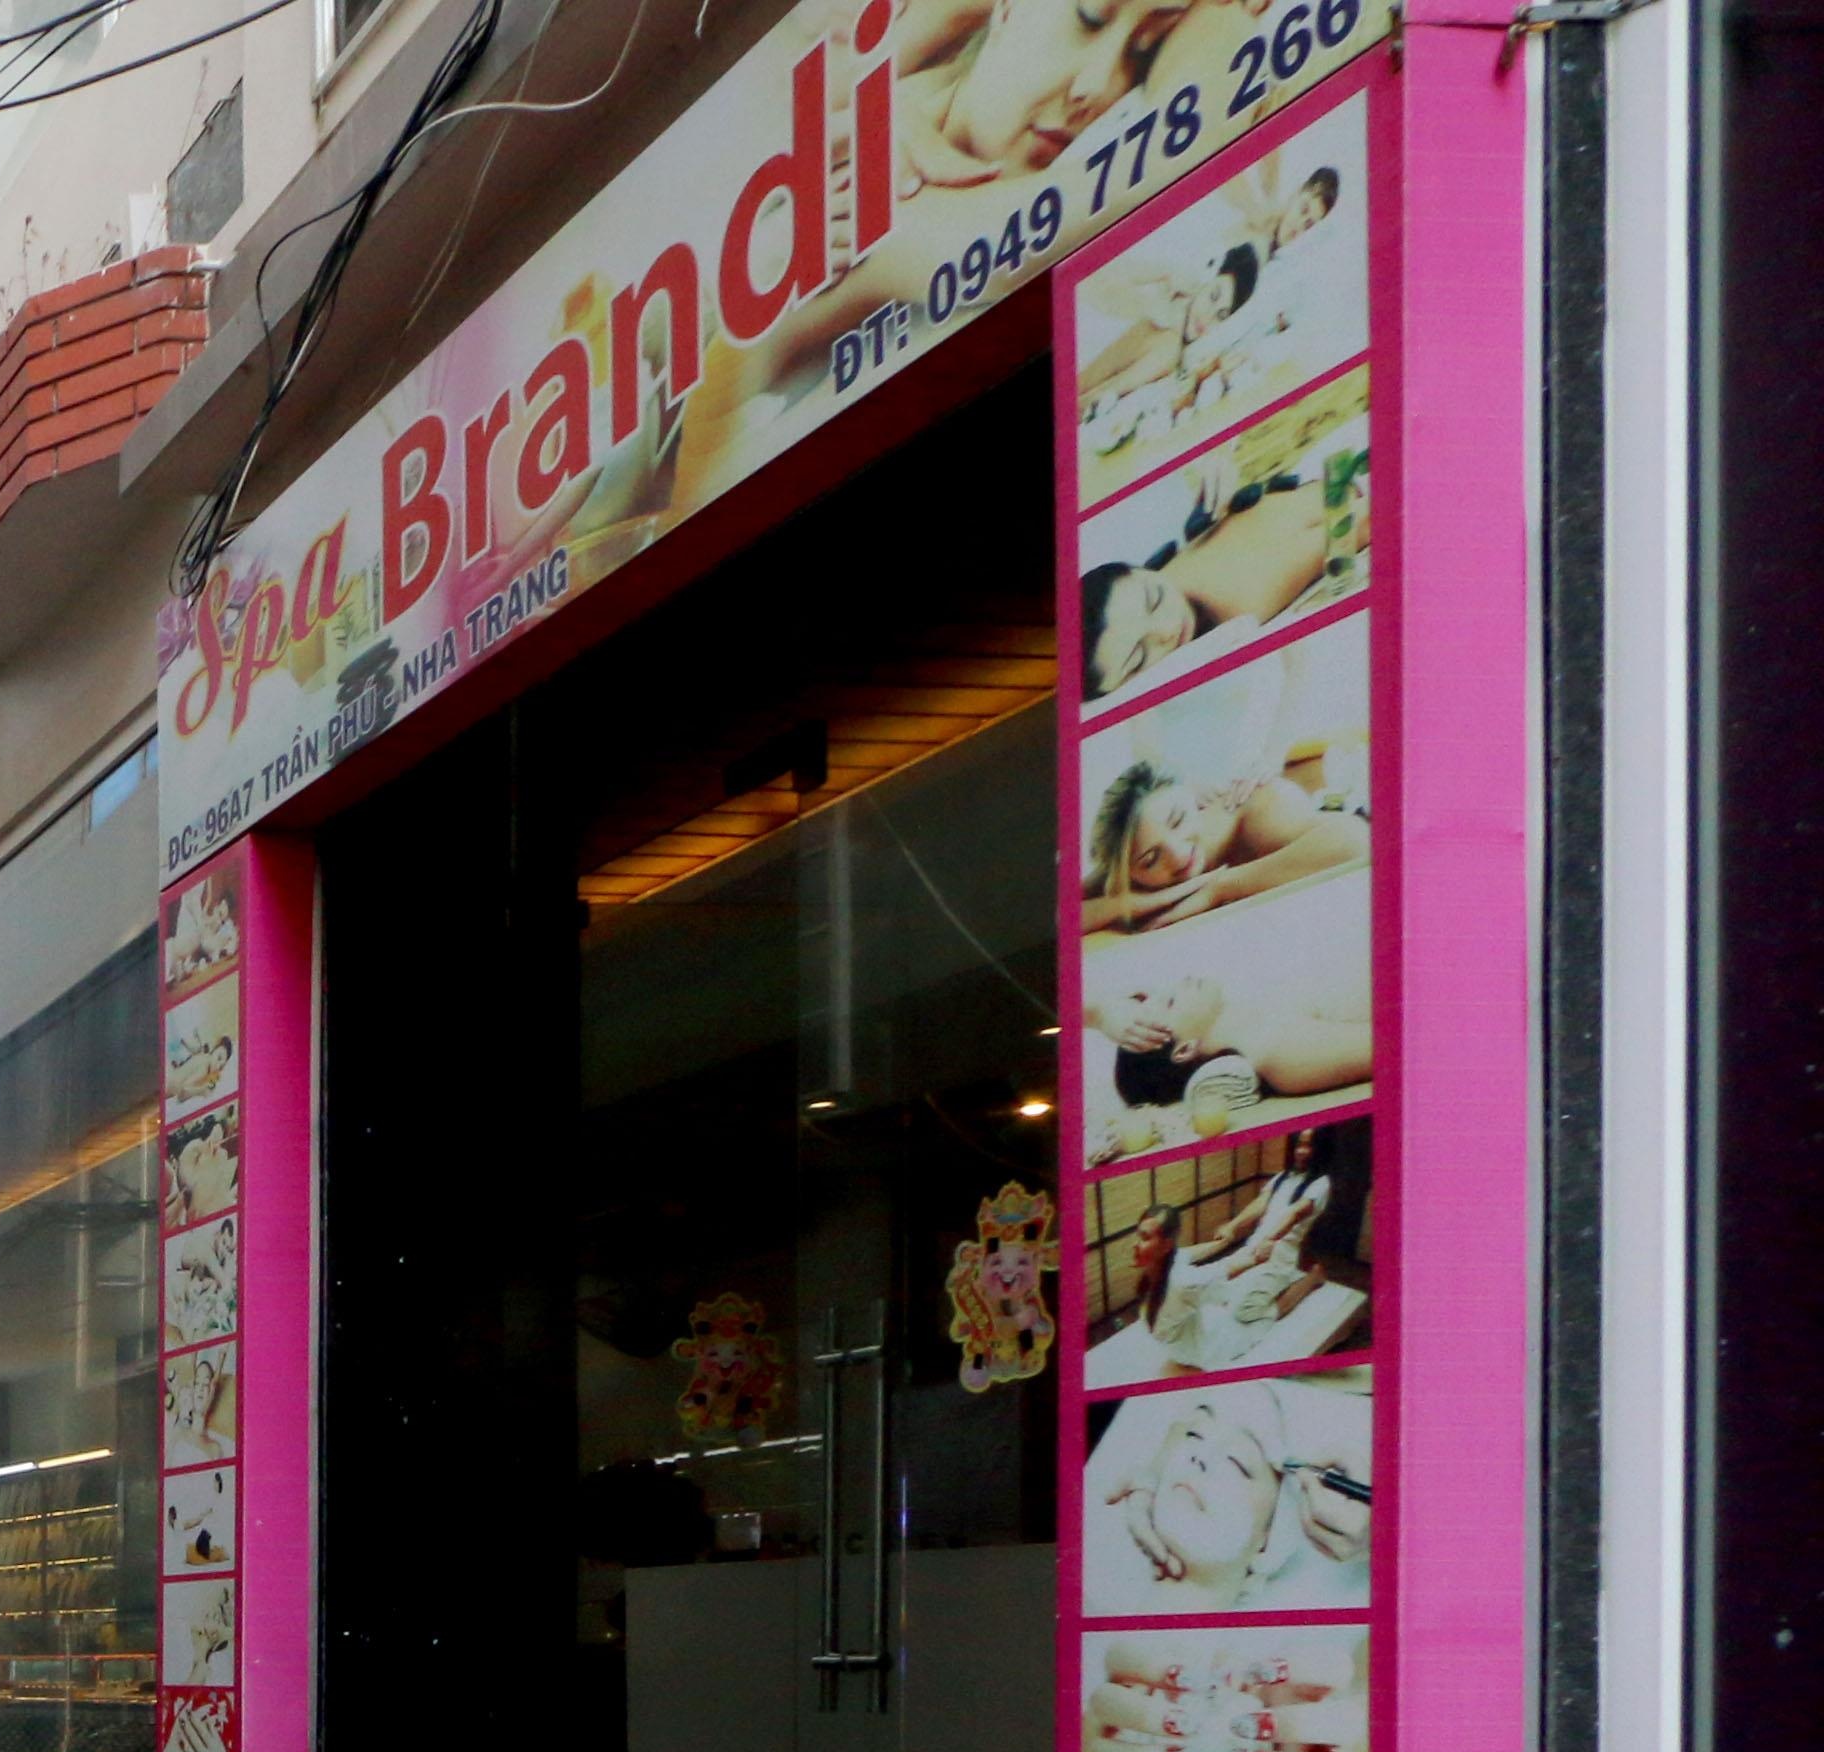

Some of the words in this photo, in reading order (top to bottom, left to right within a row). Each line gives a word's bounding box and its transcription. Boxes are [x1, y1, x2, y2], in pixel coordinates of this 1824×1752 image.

[174, 508, 353, 741] Spa
[381, 0, 893, 626] Brandi
[831, 301, 909, 395] ĐT:
[927, 185, 1063, 325] 0949
[1085, 84, 1202, 216] 778
[1227, 0, 1362, 120] 266
[167, 824, 199, 872] ĐC:
[204, 778, 254, 844] 96A7
[261, 724, 320, 801] TRẦN
[327, 676, 378, 760] PHÚ
[402, 628, 457, 704] NHA
[465, 546, 569, 657] TRANG
